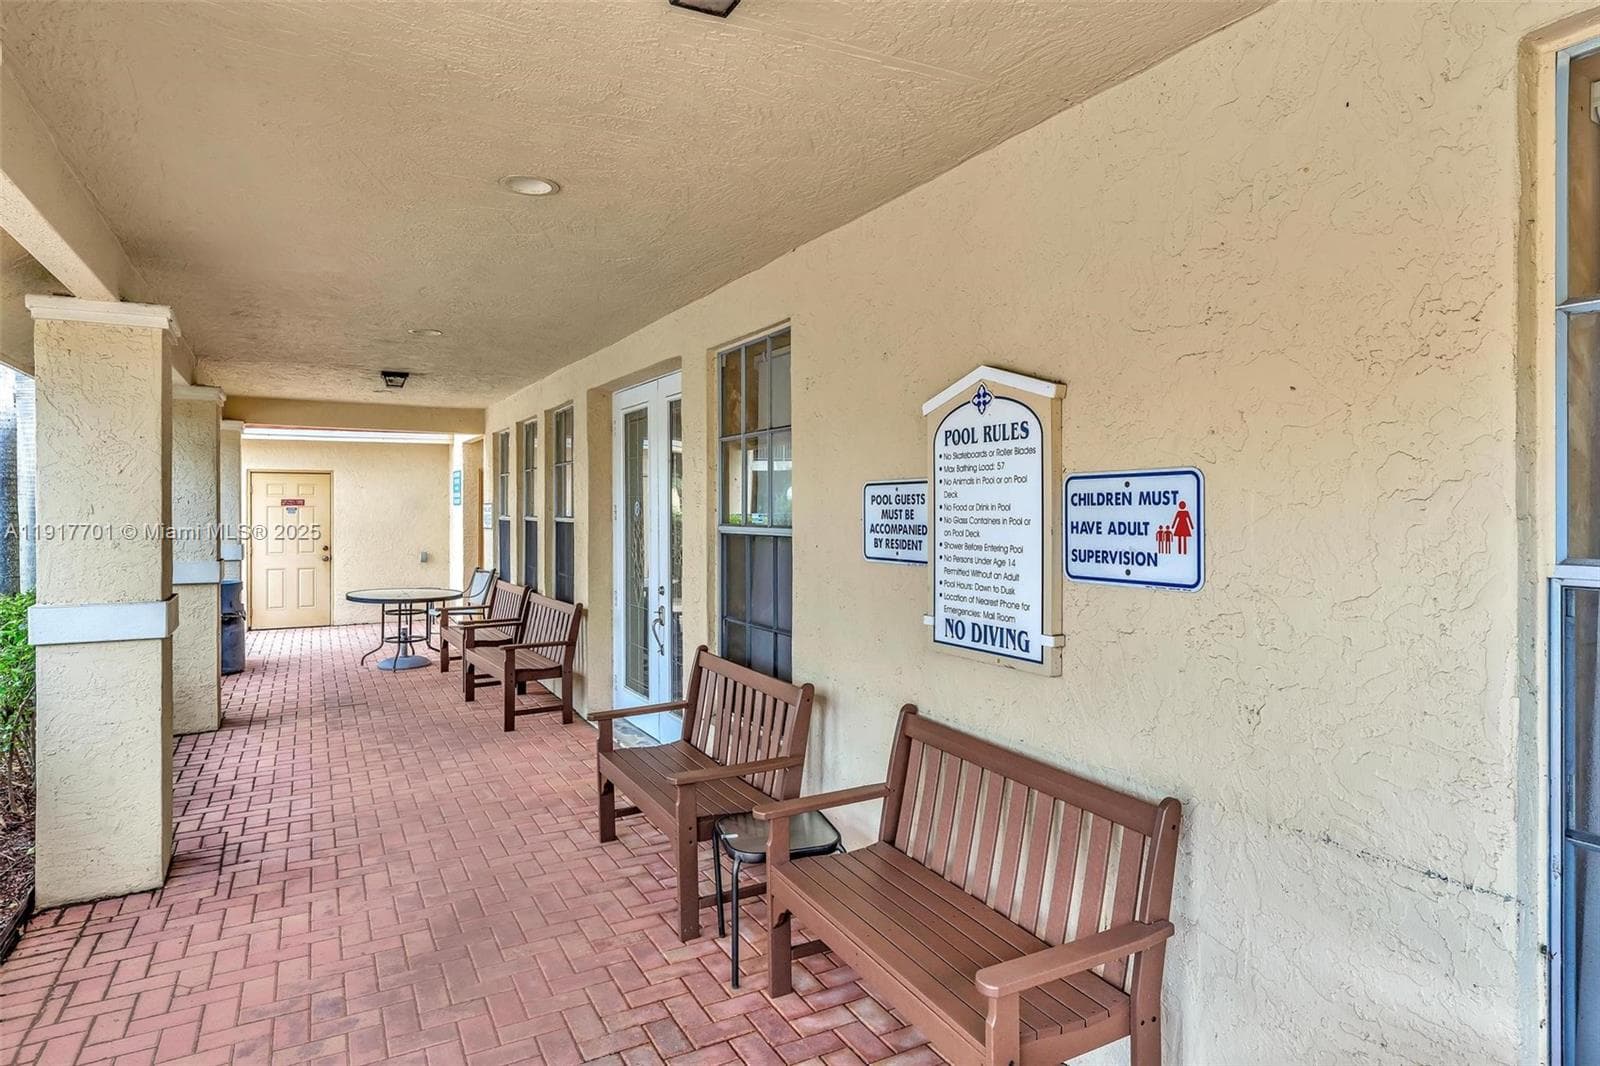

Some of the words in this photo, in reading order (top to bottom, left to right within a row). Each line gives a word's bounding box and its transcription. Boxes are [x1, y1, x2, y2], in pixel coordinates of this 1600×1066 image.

[945, 427, 978, 446] POOL
[983, 421, 1029, 442] RULES
[953, 450, 987, 459] Skateboards
[1014, 447, 1036, 455] Blades
[957, 463, 977, 473] Bathing
[997, 462, 1005, 470] 57
[953, 477, 974, 485] Animals
[871, 495, 893, 505] POOL
[895, 494, 925, 504] GUESTS
[1071, 492, 1132, 506] CHILDREN
[1138, 491, 1179, 505] MUST
[881, 509, 902, 520] MUST
[905, 510, 914, 520] BE
[969, 517, 1000, 525] Containers
[1009, 517, 1022, 526] Pool
[870, 524, 927, 535] ACCOMPANIED
[952, 529, 964, 537] Pool
[966, 529, 980, 537] Deck
[1071, 522, 1102, 534] HAVE
[1108, 522, 1149, 536] ADULT
[874, 538, 883, 548] BY
[885, 539, 922, 550] RESIDENT
[965, 543, 983, 551] Before
[984, 544, 1008, 555] Entering
[1010, 545, 1023, 553] Pool
[953, 555, 972, 564] Persons
[975, 556, 992, 565] Under
[993, 558, 1006, 567] Age
[1008, 558, 1016, 566] 14
[1072, 549, 1158, 566] SUPERVISION
[944, 567, 969, 576] Permitted
[971, 570, 992, 579] Without
[1003, 573, 1019, 581] Adult
[975, 583, 991, 592] Dawn
[1001, 586, 1015, 595] Dusk
[944, 593, 967, 602] Location
[976, 596, 998, 606] Nearest
[1000, 599, 1019, 609] Phone
[1022, 601, 1030, 611] for
[983, 611, 995, 619] Mail
[997, 613, 1016, 622] Room
[945, 618, 965, 640] NO
[971, 623, 1030, 653] DIVING
